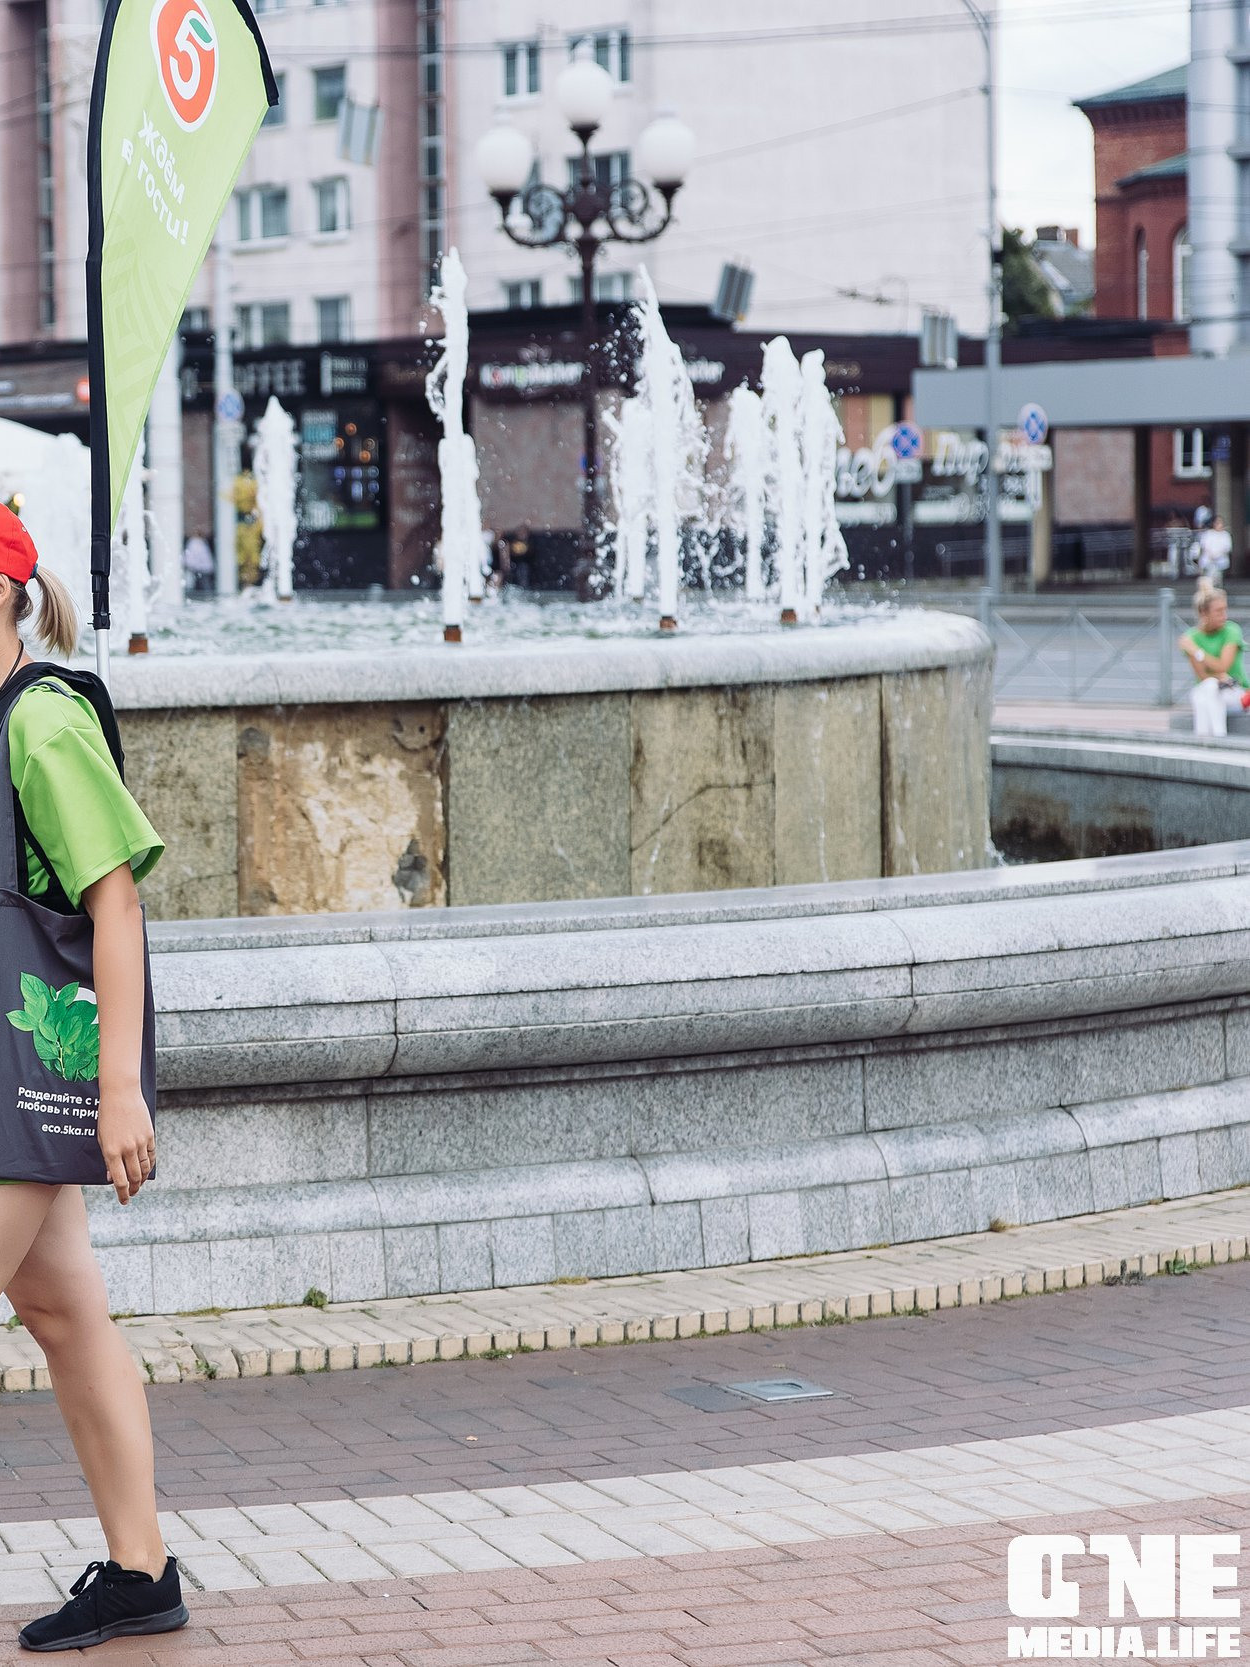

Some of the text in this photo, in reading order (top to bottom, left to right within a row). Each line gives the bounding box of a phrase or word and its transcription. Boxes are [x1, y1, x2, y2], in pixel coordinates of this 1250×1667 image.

[18, 1086, 82, 1105] Разделяйте
[16, 1100, 60, 1114] любовь
[62, 1106, 70, 1115] к
[41, 1123, 95, 1136] eco.5ka.ru
